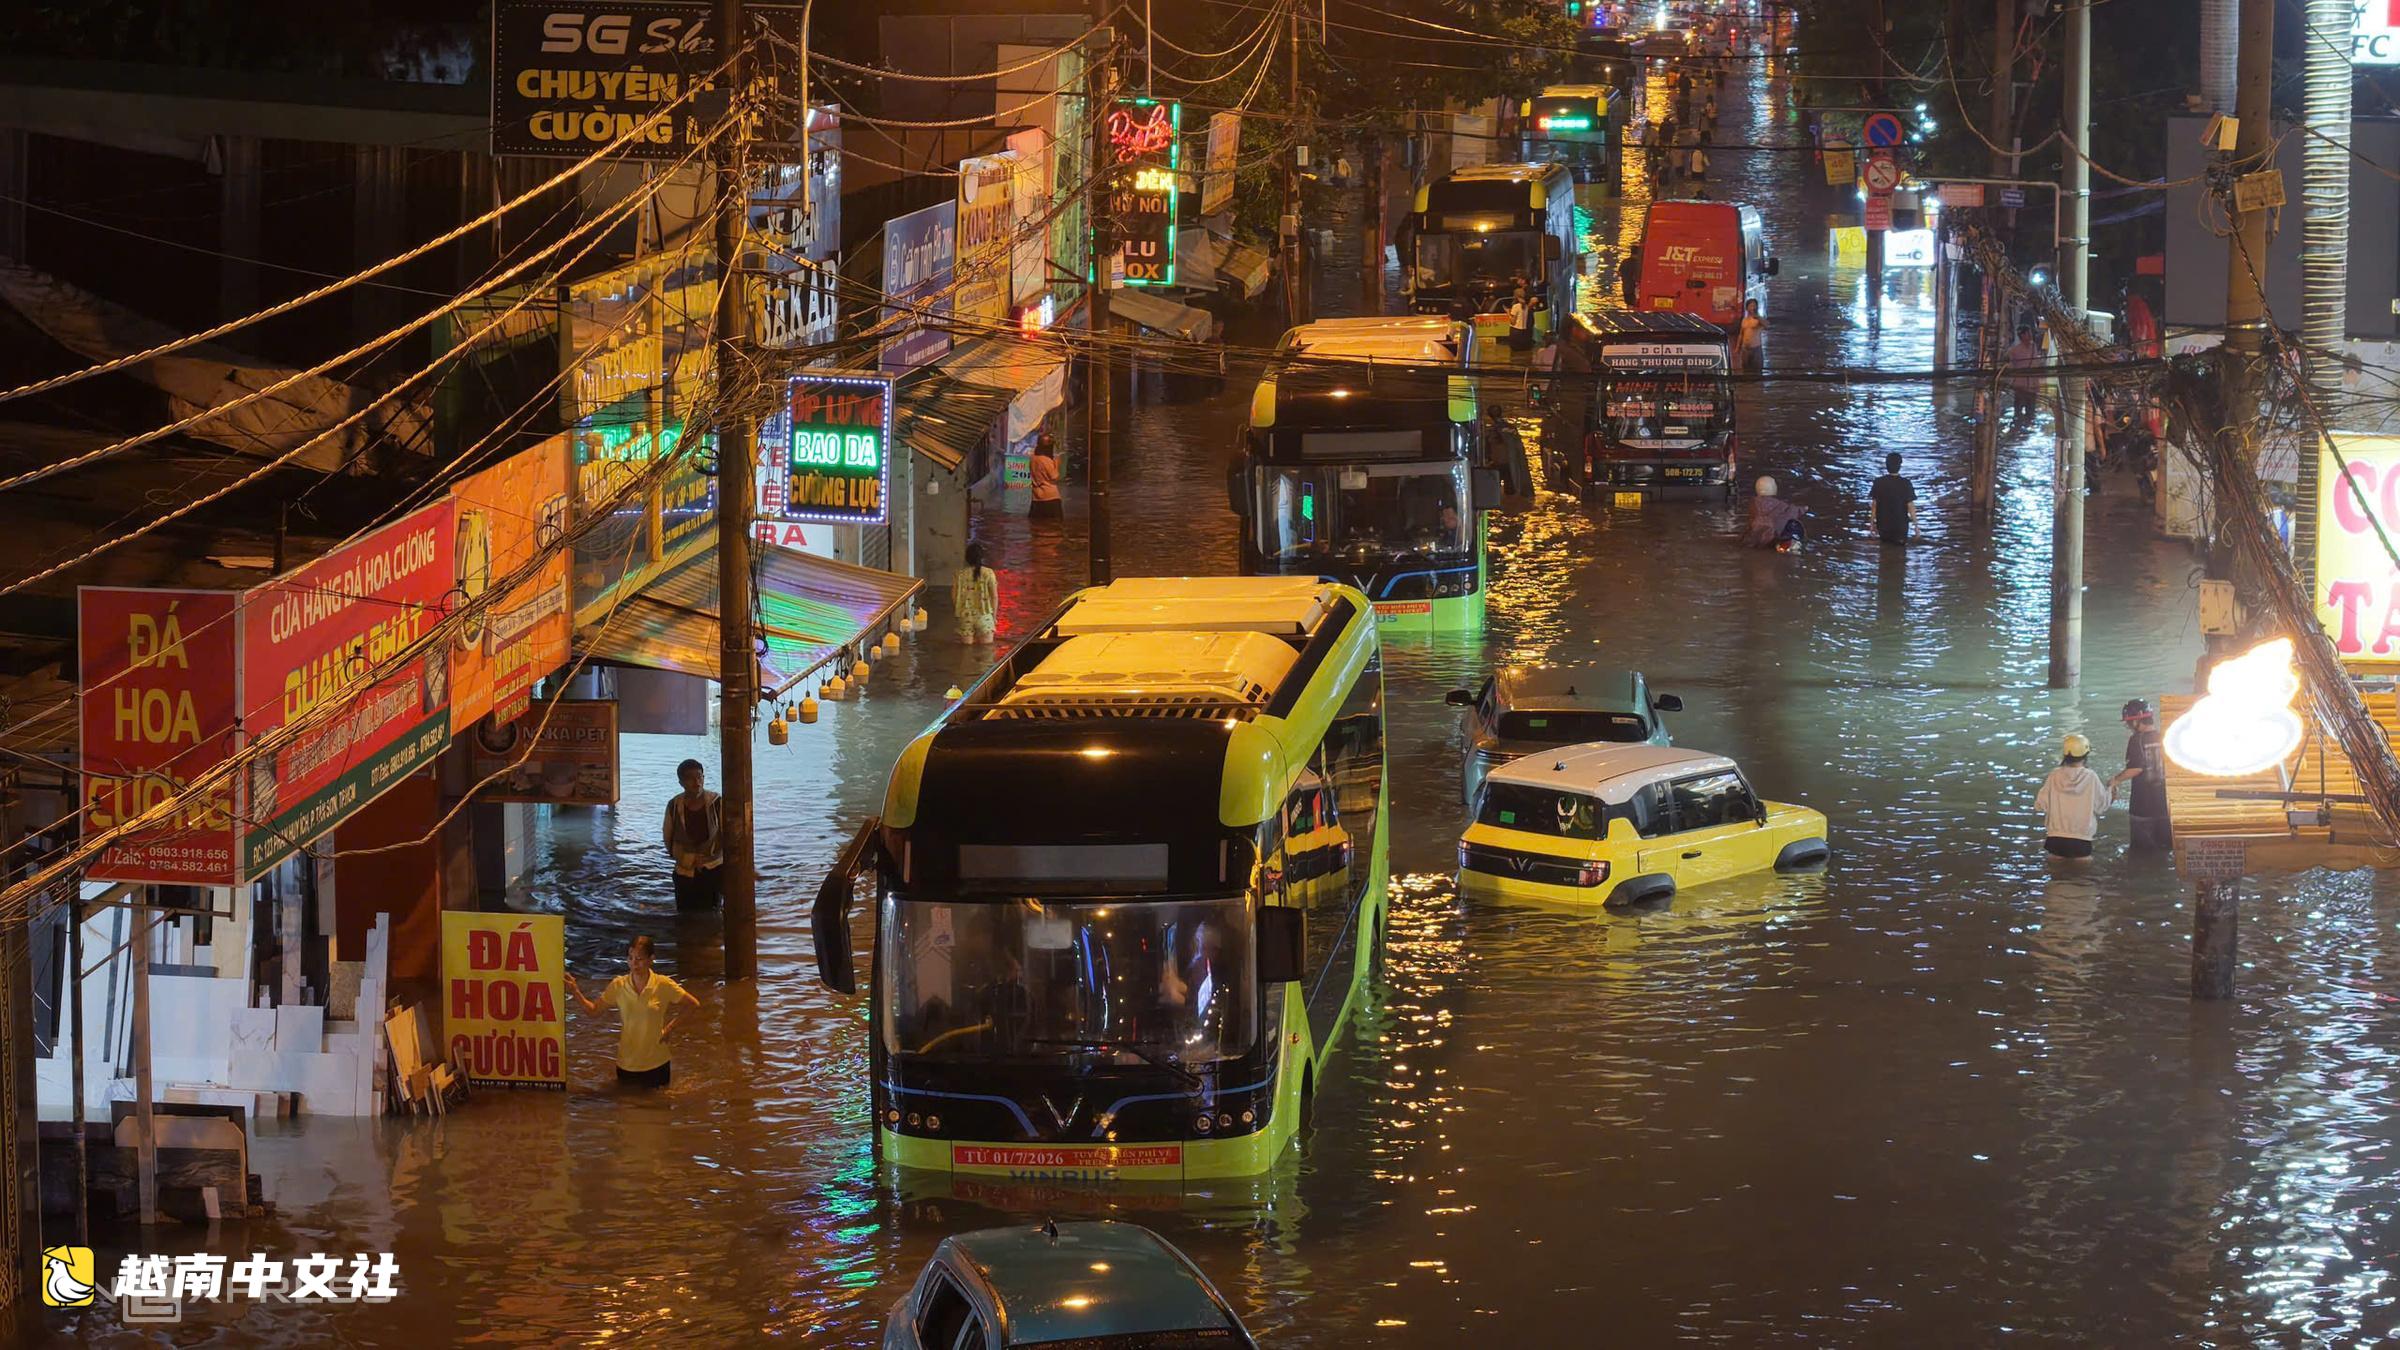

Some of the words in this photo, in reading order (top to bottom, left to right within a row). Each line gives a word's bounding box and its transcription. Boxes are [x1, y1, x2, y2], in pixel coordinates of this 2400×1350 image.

[541, 14, 632, 54] SG
[2352, 34, 2390, 57] FC
[517, 65, 678, 102] CHUYÊN
[529, 105, 673, 144] CƯỜNG
[1125, 241, 1156, 257] LU
[1658, 245, 1701, 262] J&T
[795, 431, 840, 465] BAO
[845, 434, 877, 467] DA
[270, 601, 302, 645] CỬA
[304, 574, 342, 630] HÀNG
[344, 555, 363, 608] ĐÁ
[365, 551, 392, 597] HOA
[393, 527, 436, 581] CƯƠNG
[127, 600, 189, 669] ĐÁ
[114, 687, 201, 744] HOA
[522, 726, 571, 742] NKA
[576, 727, 608, 742] PET
[467, 922, 540, 972] ĐÁ
[451, 978, 557, 1022] HOA
[451, 1028, 560, 1079] CƯƠNG
[964, 1147, 989, 1164] TỪ
[993, 1152, 1064, 1165] 01/7/2026
